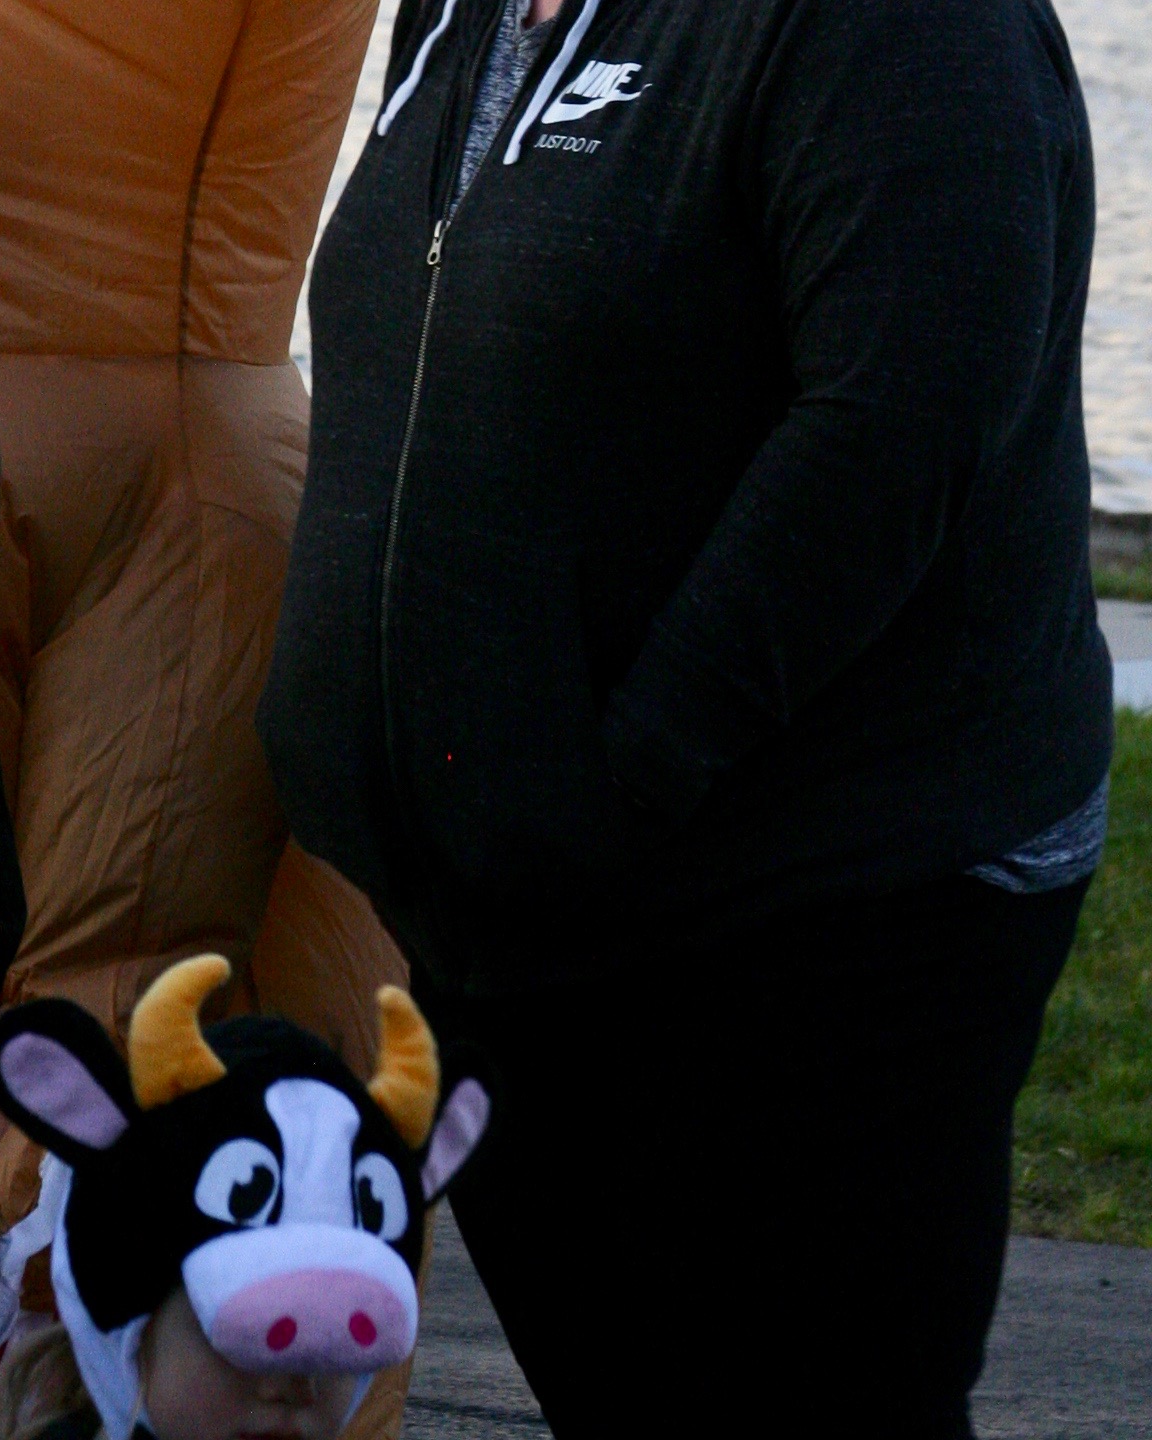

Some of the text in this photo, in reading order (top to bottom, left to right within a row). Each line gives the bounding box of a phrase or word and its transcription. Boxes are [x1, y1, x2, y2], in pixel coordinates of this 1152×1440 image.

[564, 60, 642, 99] NIKE
[533, 133, 602, 154] JUST DO IT
